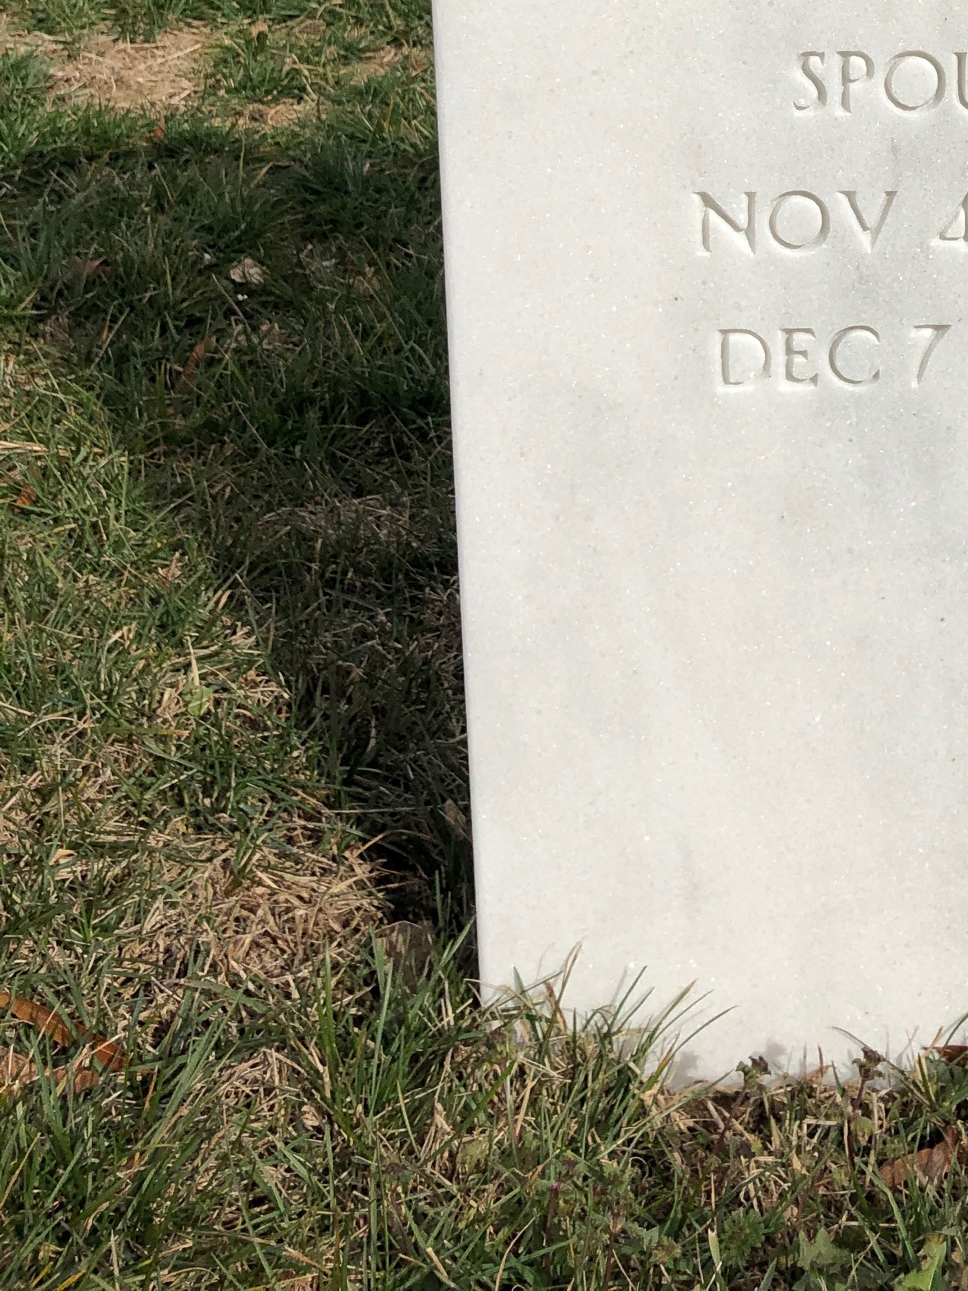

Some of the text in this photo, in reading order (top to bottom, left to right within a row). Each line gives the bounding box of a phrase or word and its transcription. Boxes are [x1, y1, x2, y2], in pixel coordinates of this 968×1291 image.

[693, 188, 898, 255] NOV
[716, 323, 882, 388] DEC
[912, 322, 952, 387] 7
